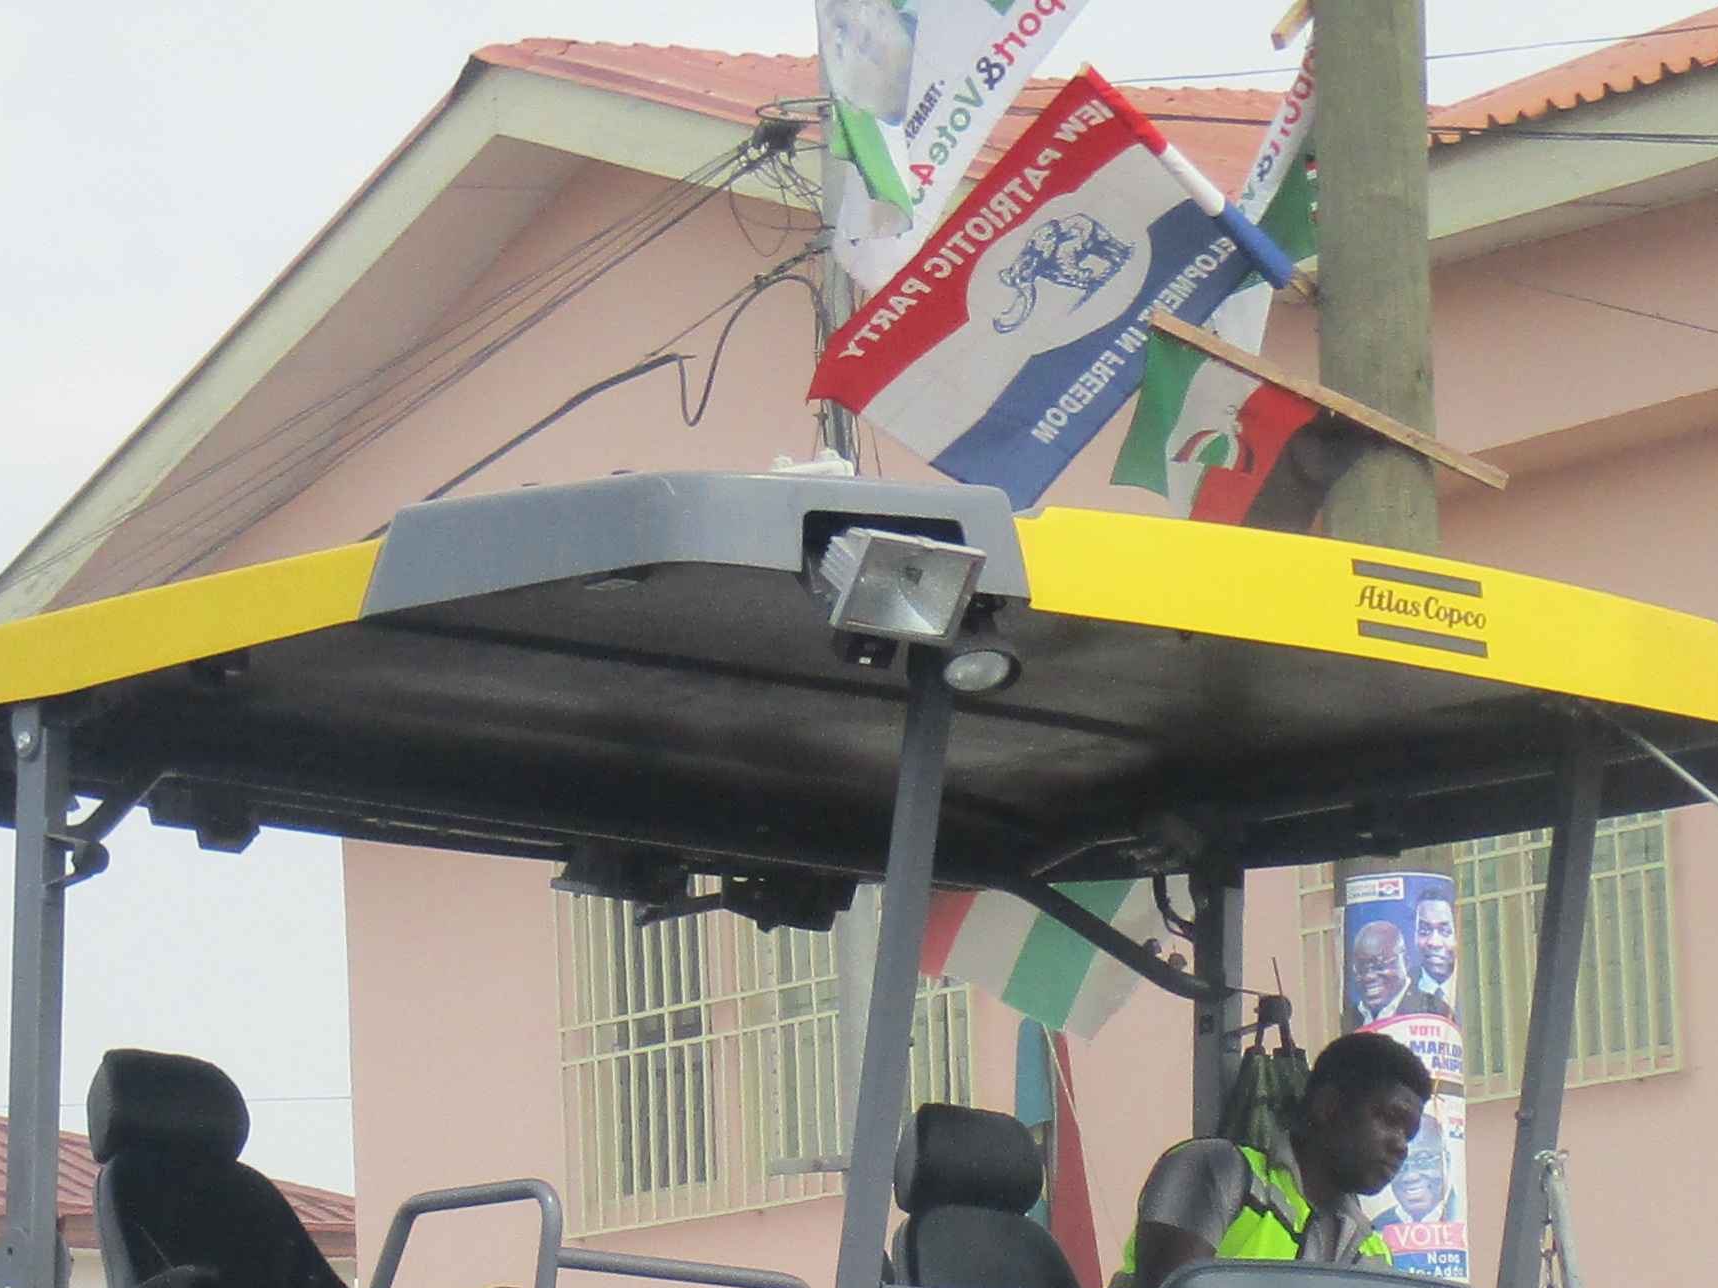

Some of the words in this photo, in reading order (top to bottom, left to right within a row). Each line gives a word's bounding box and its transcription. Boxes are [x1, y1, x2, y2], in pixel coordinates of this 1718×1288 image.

[1355, 585, 1421, 617] Atlas
[1423, 596, 1487, 630] Copco
[1394, 1223, 1454, 1247] VOTE
